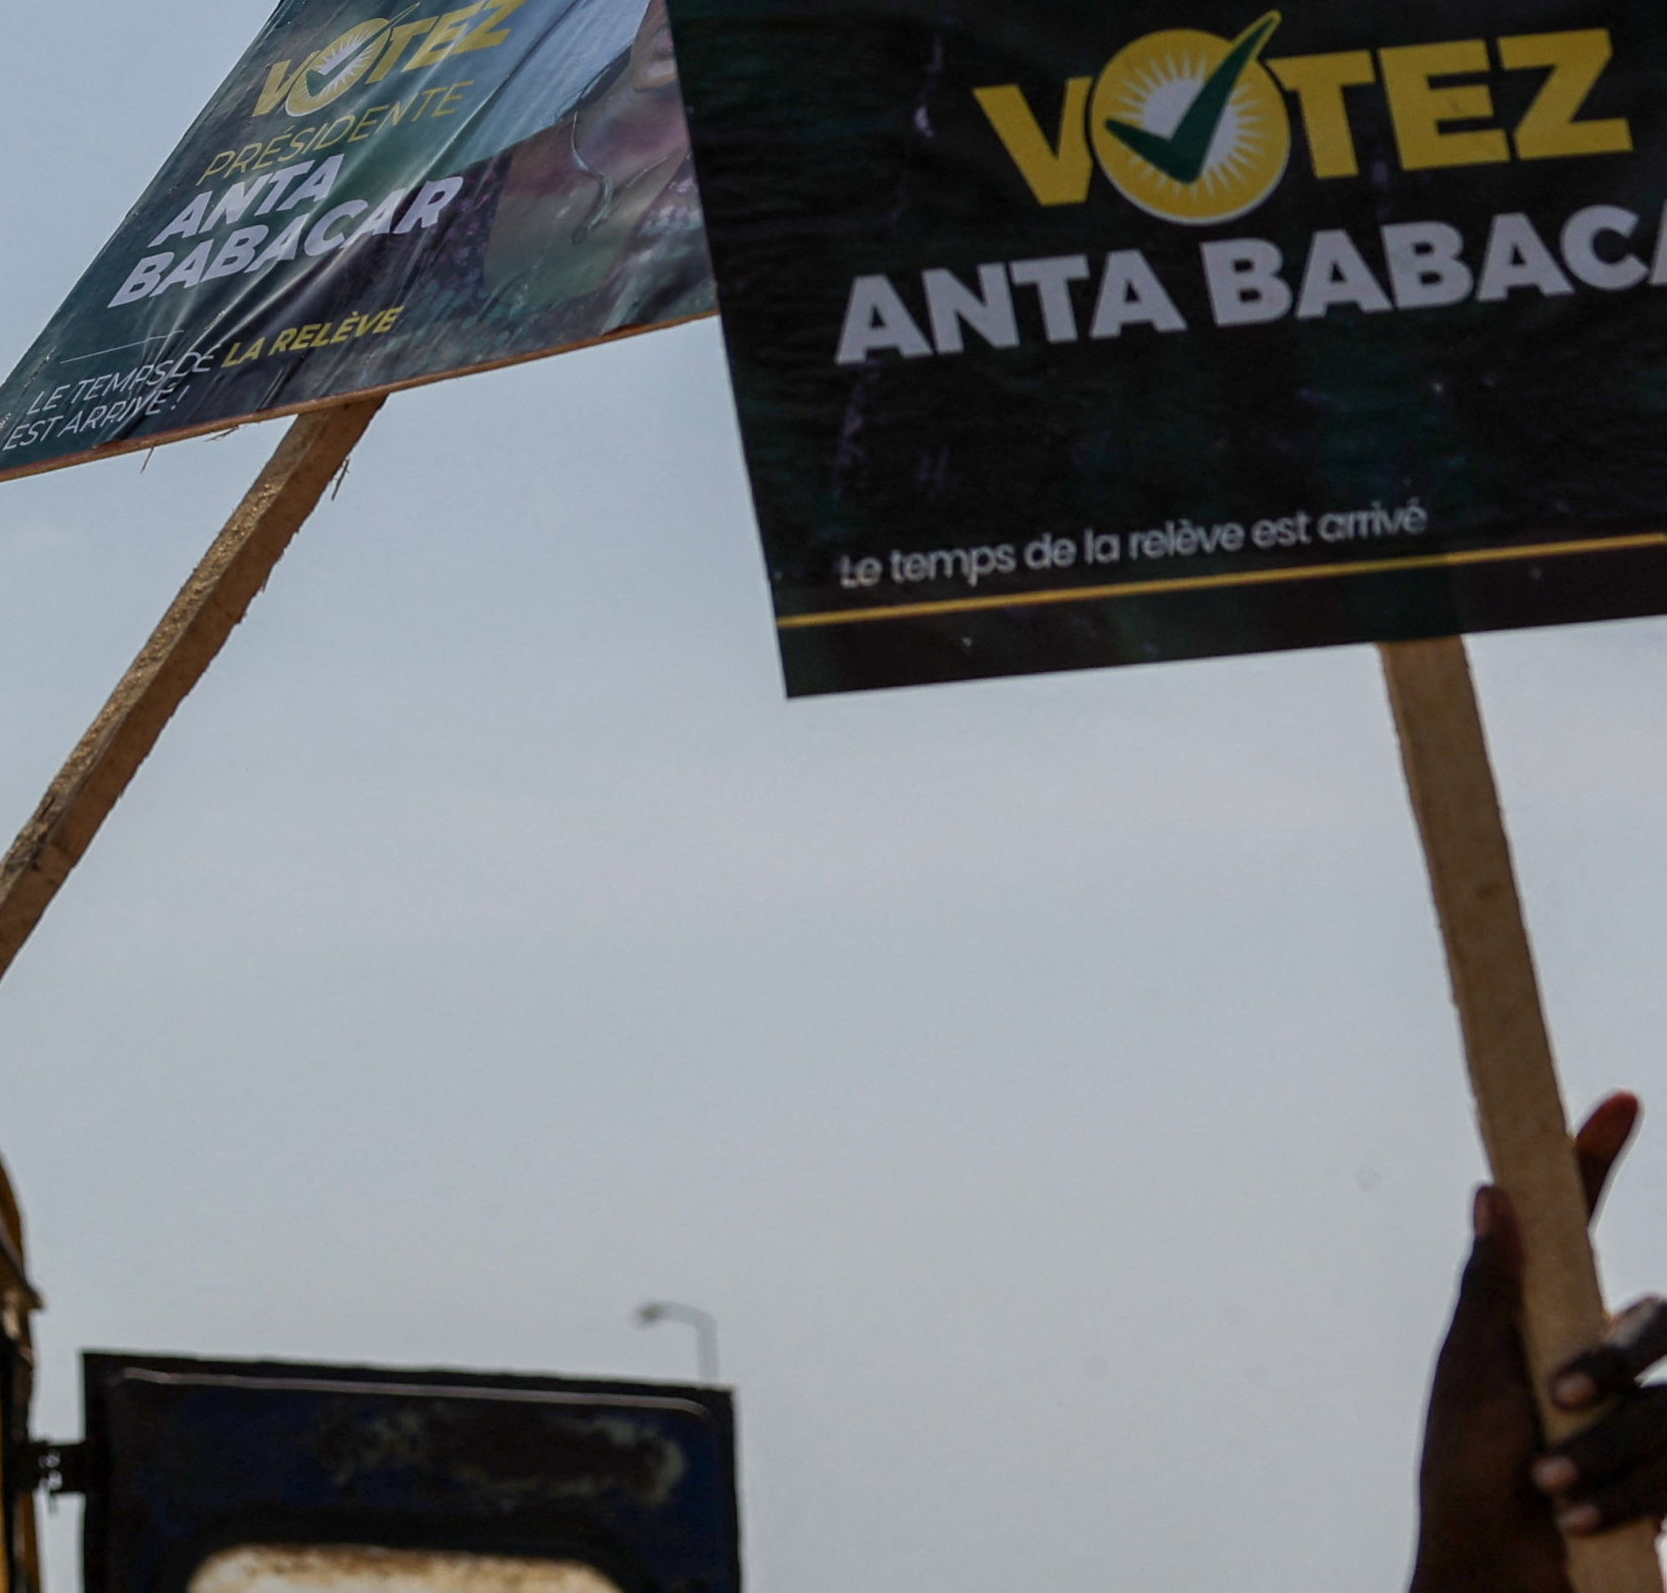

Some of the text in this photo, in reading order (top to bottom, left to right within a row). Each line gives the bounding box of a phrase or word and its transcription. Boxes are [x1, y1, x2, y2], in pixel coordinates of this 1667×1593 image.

[196, 79, 476, 187] PRÉSIDENTE
[973, 10, 1634, 226] VOTEZ
[107, 175, 465, 308] BABACAR
[147, 153, 345, 248] ANTA
[834, 198, 1667, 366] ANTA BABAC
[26, 305, 405, 416] LE TEMPS DE LA RELÈVE
[2, 415, 58, 452] EST
[58, 385, 176, 440] ARRIVÉ
[838, 496, 1429, 589] Le temps de la relève est arrivé
